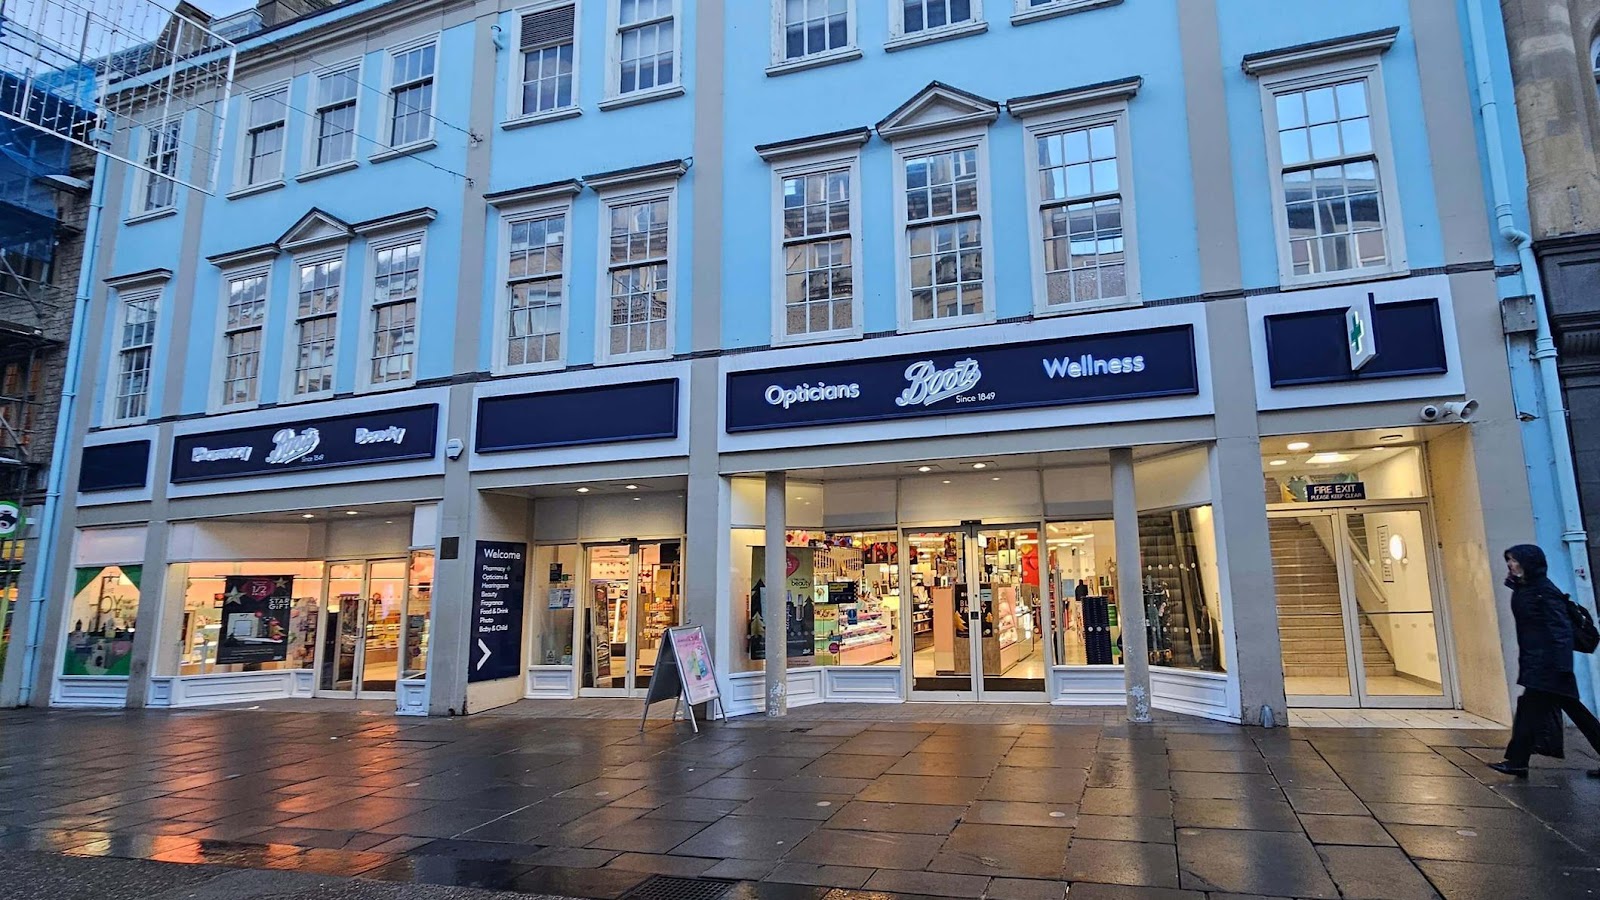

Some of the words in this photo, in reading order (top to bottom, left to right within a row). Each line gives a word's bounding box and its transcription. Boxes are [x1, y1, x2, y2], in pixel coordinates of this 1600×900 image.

[1042, 354, 1145, 379] Wellness
[895, 358, 982, 407] Boots
[764, 381, 860, 409] Opticians
[955, 394, 976, 404] Since
[977, 391, 996, 402] 1849
[265, 427, 321, 464] Boots
[1313, 485, 1333, 495] FIRE
[1335, 484, 1356, 493] EXIT
[483, 548, 521, 559] Welcome
[482, 573, 504, 581] Opticians
[479, 625, 491, 633] Baby
